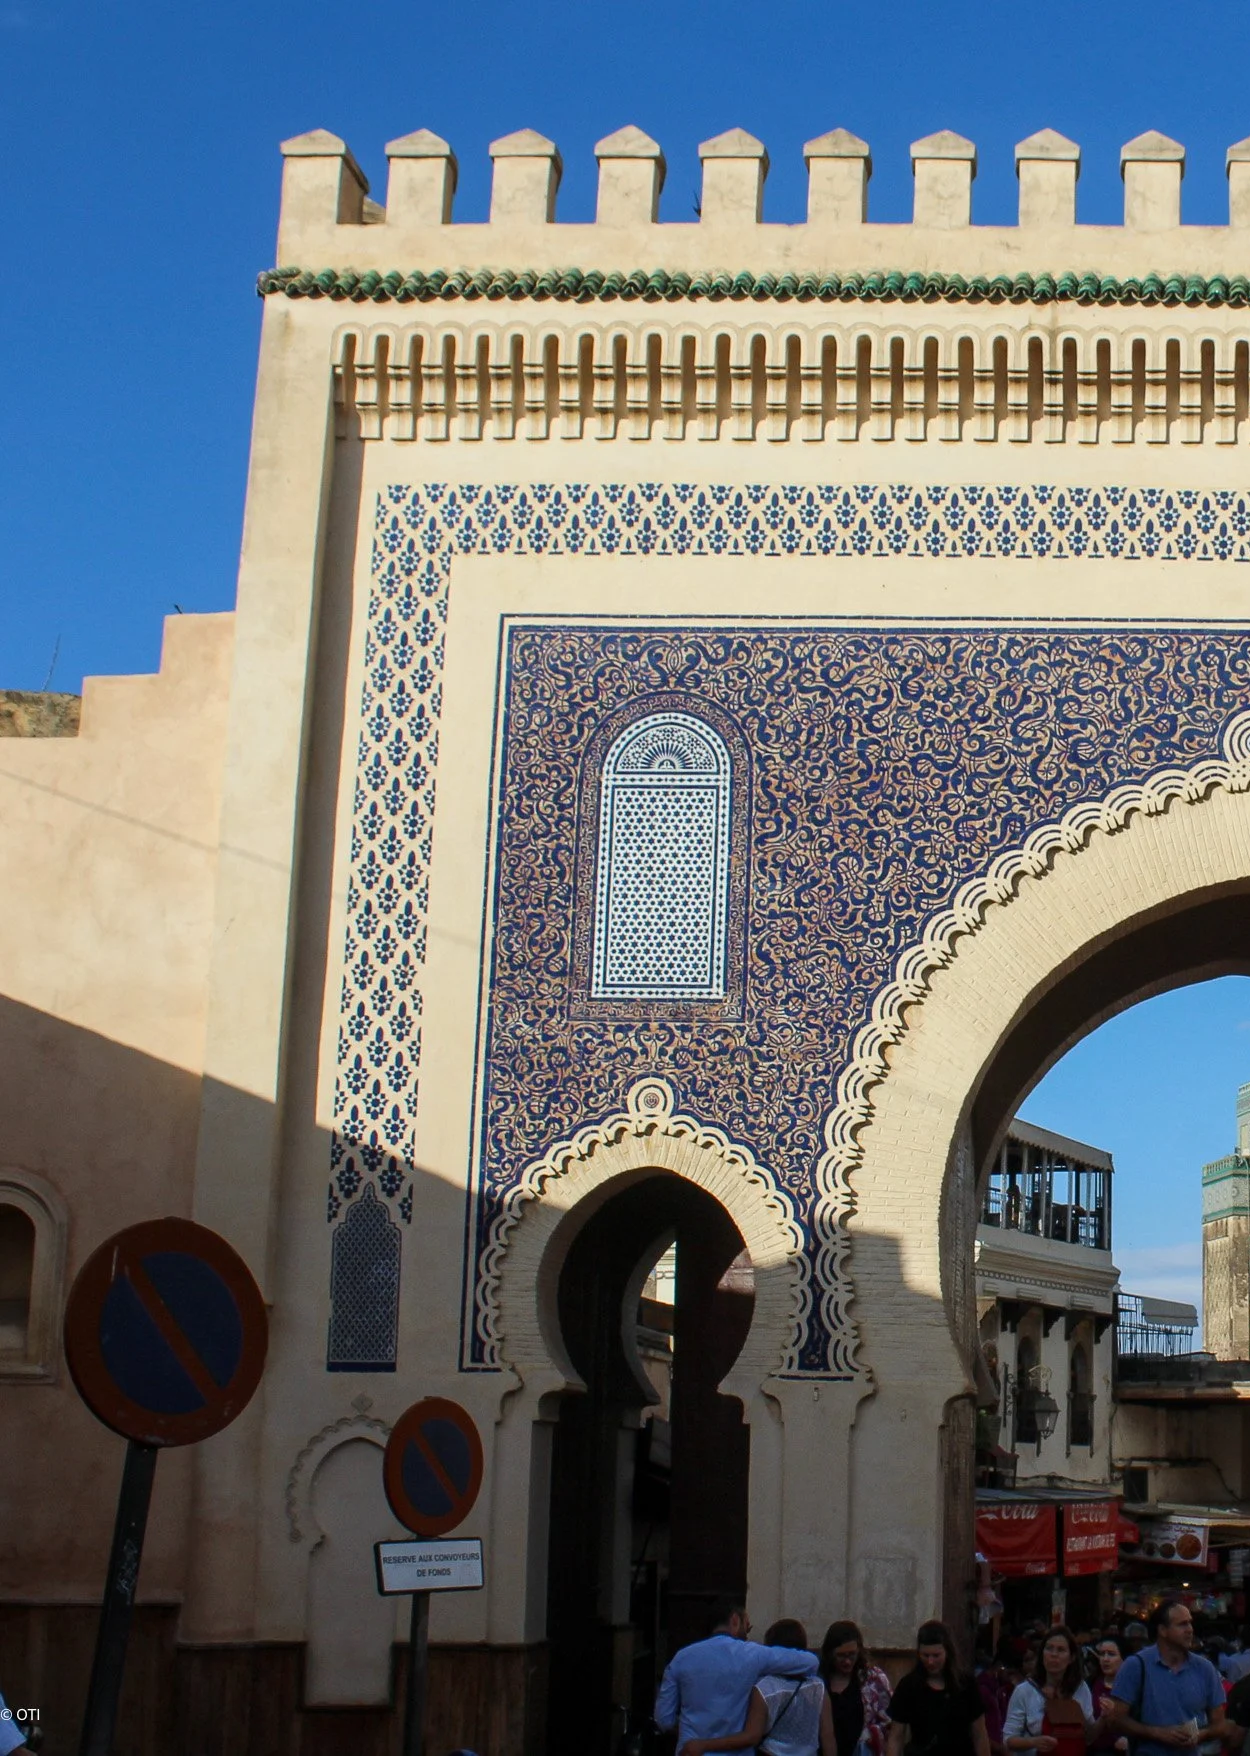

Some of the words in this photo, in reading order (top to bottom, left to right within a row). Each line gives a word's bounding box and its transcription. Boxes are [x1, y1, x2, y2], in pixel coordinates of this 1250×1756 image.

[383, 1555, 416, 1564] RESERVE
[418, 1554, 433, 1563] AUX
[434, 1552, 480, 1562] CONVOYEURS
[416, 1569, 426, 1577] DE
[428, 1568, 451, 1577] FONDS
